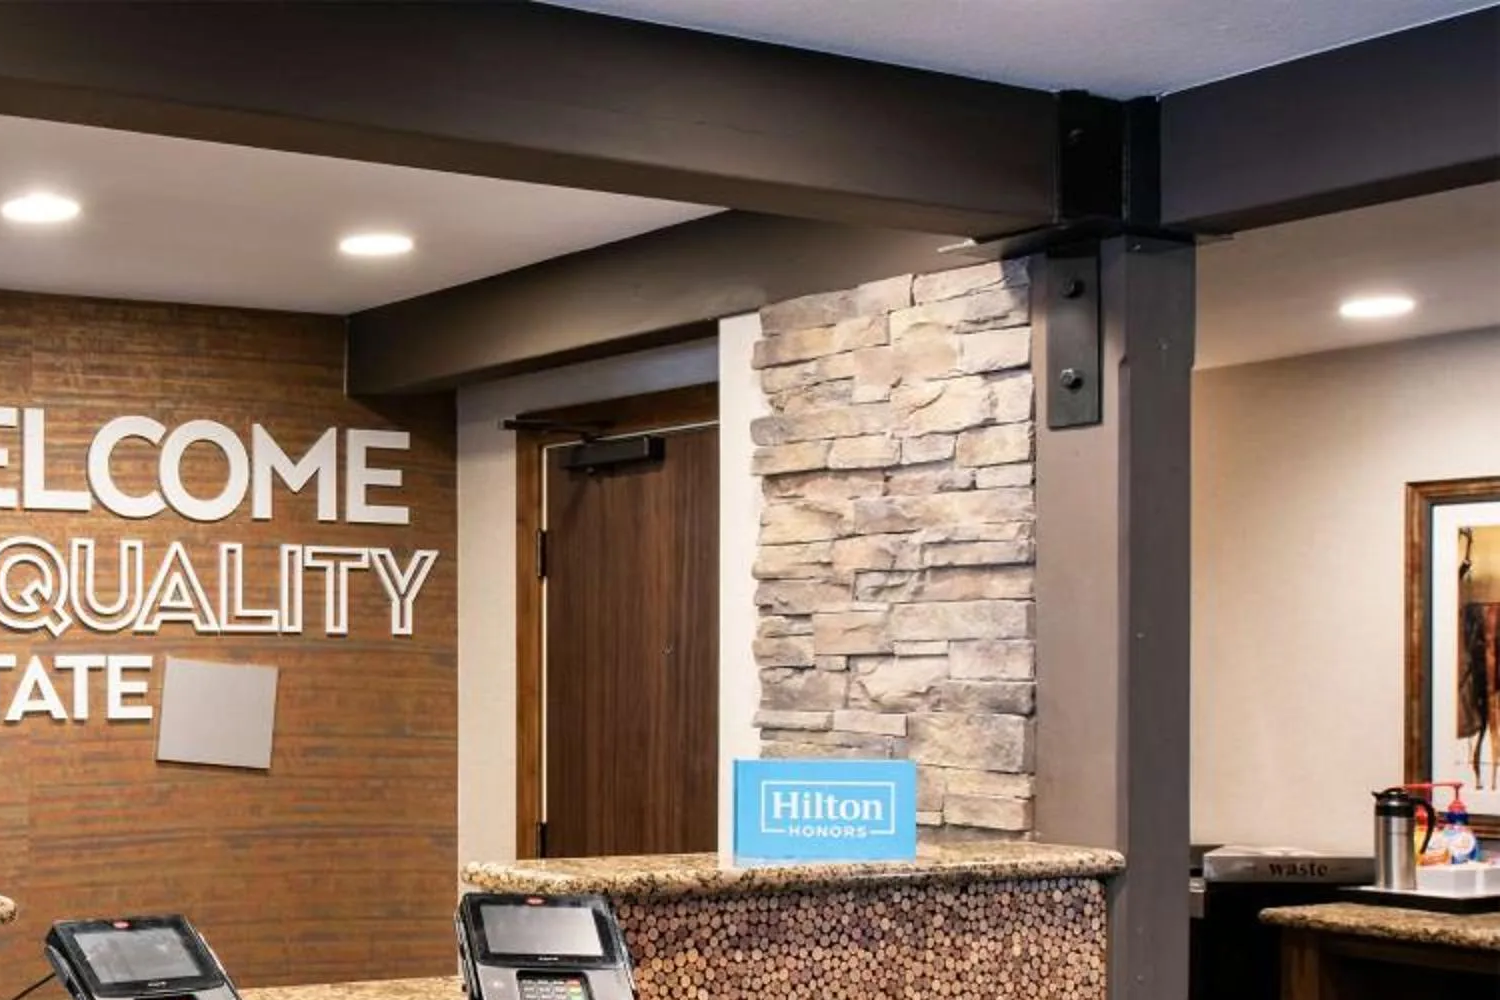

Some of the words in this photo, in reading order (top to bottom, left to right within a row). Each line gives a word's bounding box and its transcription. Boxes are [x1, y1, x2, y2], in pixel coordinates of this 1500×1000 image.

[772, 791, 884, 821] Hilton
[788, 825, 868, 838] HONORS
[1268, 861, 1328, 877] waste
